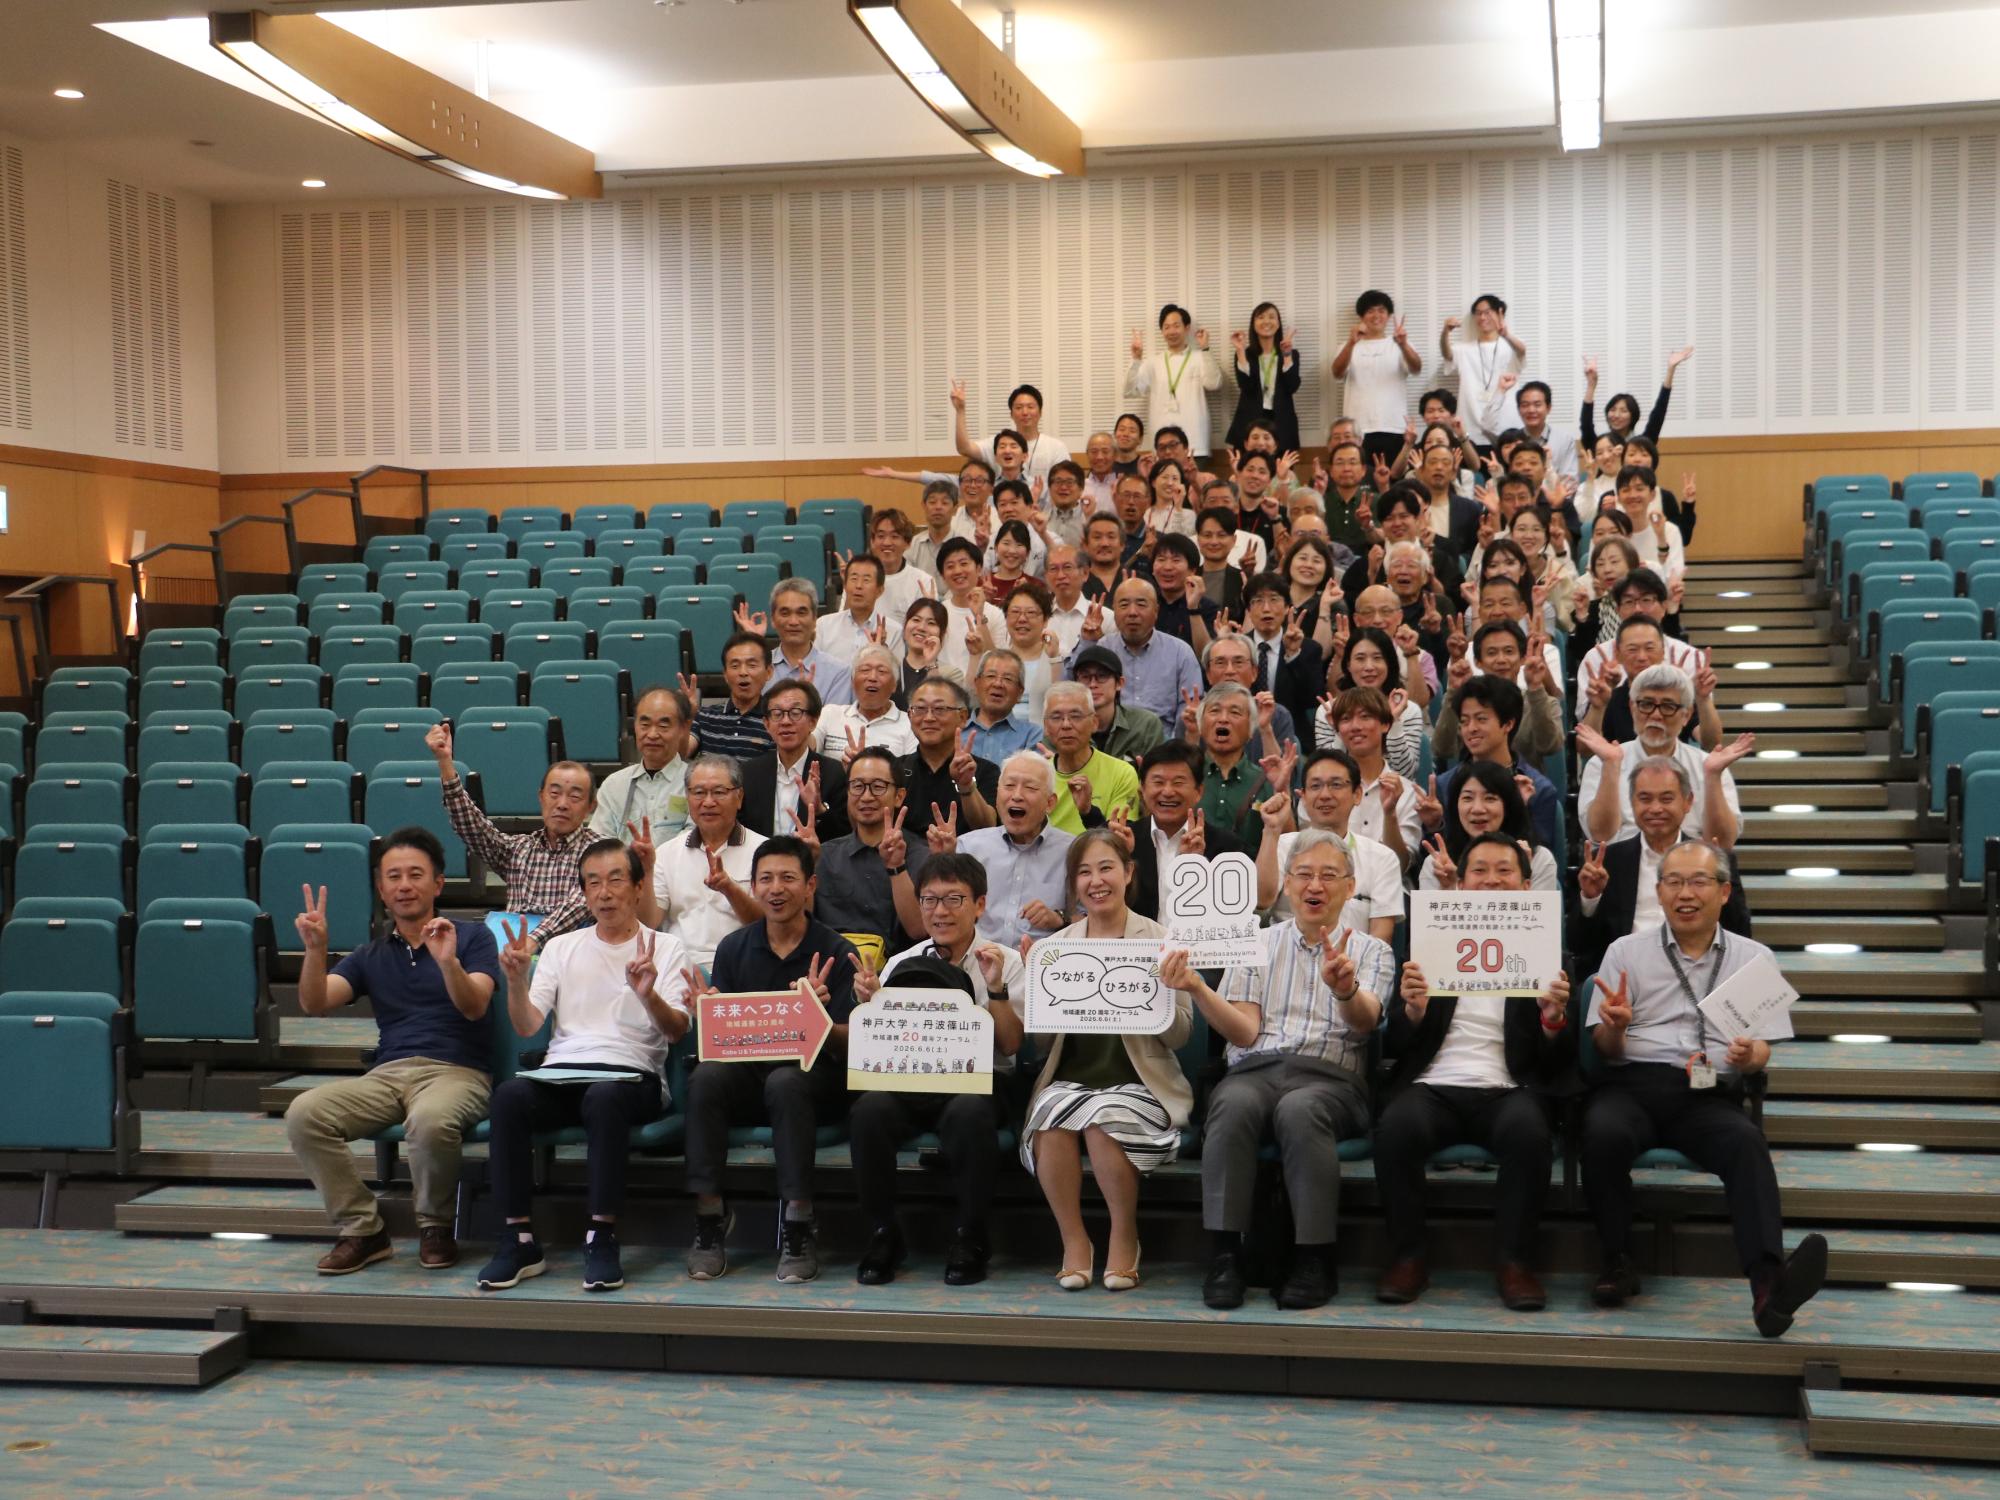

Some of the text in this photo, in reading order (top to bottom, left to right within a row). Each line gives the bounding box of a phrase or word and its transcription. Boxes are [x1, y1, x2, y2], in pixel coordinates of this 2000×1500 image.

[1173, 860, 1249, 917] 20
[1429, 902, 1473, 911] 神戸大学
[1487, 901, 1542, 911] 丹波篠山市
[1050, 971, 1096, 983] つながる
[1105, 982, 1151, 993] ひろがる
[712, 1001, 804, 1018] 未来へつなぐ
[862, 1018, 908, 1029] 神戸大学
[923, 1019, 981, 1031] 丹波篠山市
